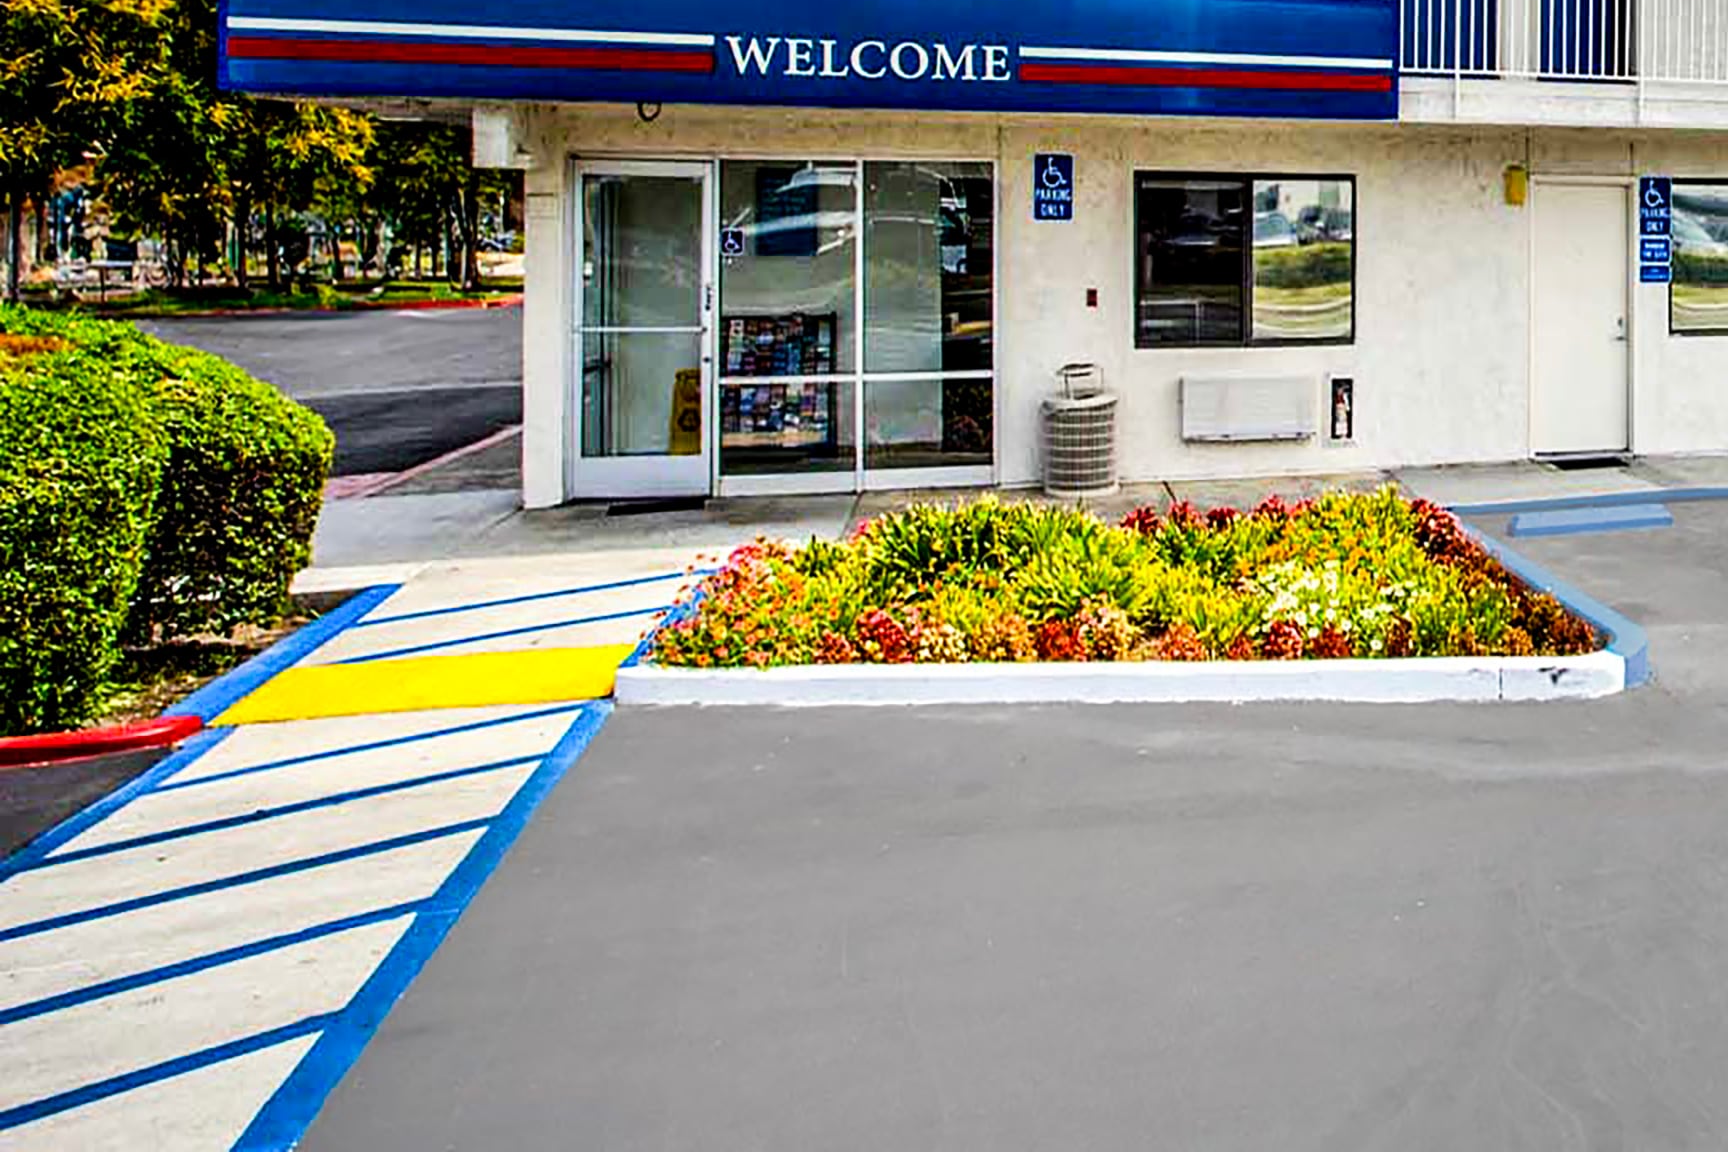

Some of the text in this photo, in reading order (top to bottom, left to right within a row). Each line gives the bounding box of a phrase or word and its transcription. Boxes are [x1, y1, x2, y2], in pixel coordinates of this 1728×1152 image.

[724, 35, 1012, 82] WELCOME
[1035, 188, 1072, 202] PARKING
[1040, 203, 1068, 217] ONLY
